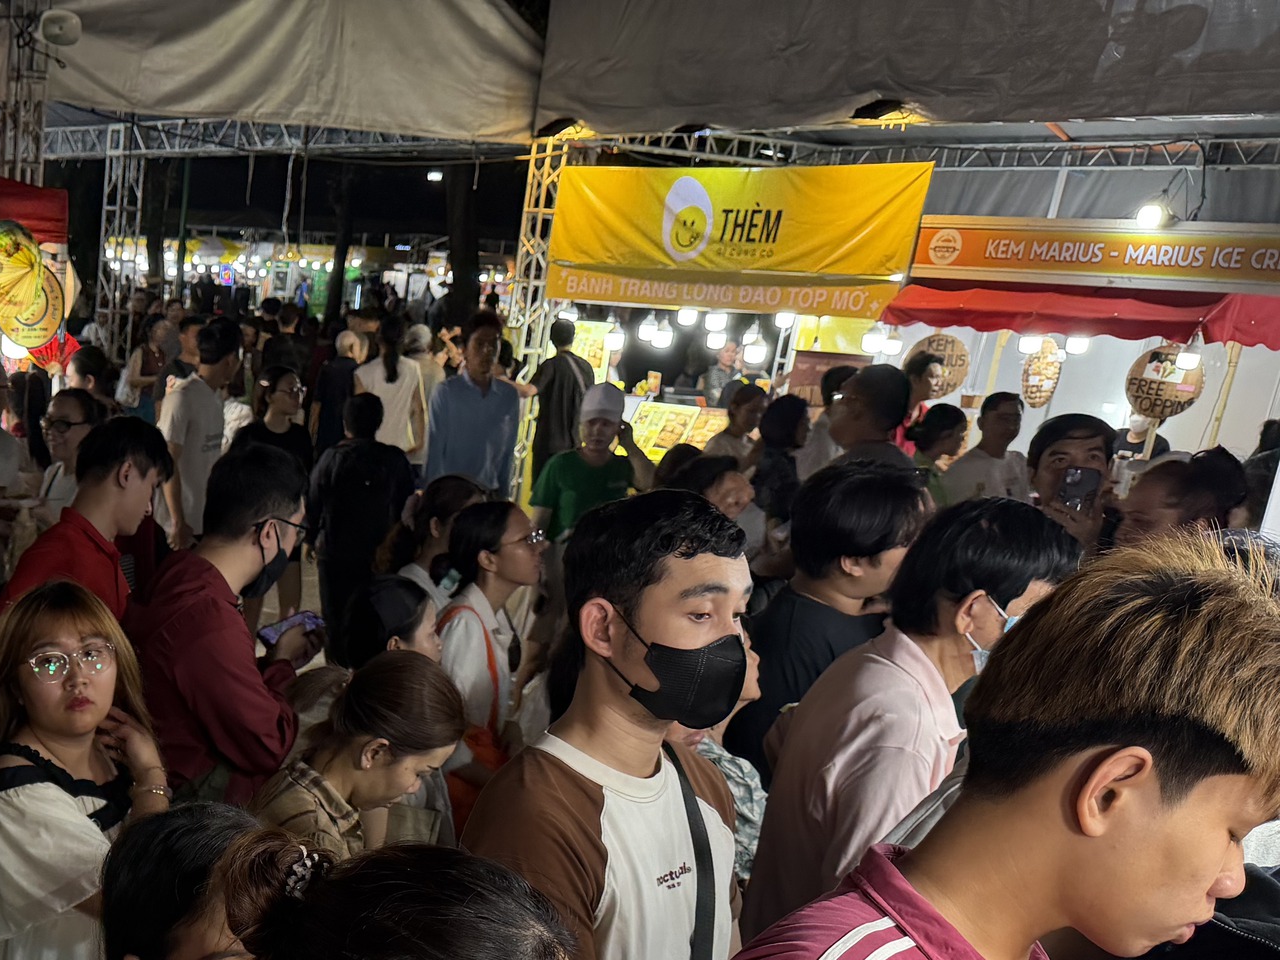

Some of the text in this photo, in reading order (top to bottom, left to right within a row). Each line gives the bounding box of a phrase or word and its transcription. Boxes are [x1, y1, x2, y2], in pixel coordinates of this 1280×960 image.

[720, 202, 783, 244] THÈM
[984, 239, 1024, 259] KEM
[1029, 240, 1105, 263] MARIUS
[1124, 243, 1207, 268] MARIUS
[1211, 246, 1246, 269] ICE
[1250, 248, 1280, 270] CR
[927, 338, 956, 351] KEM
[1127, 377, 1166, 397] FREE
